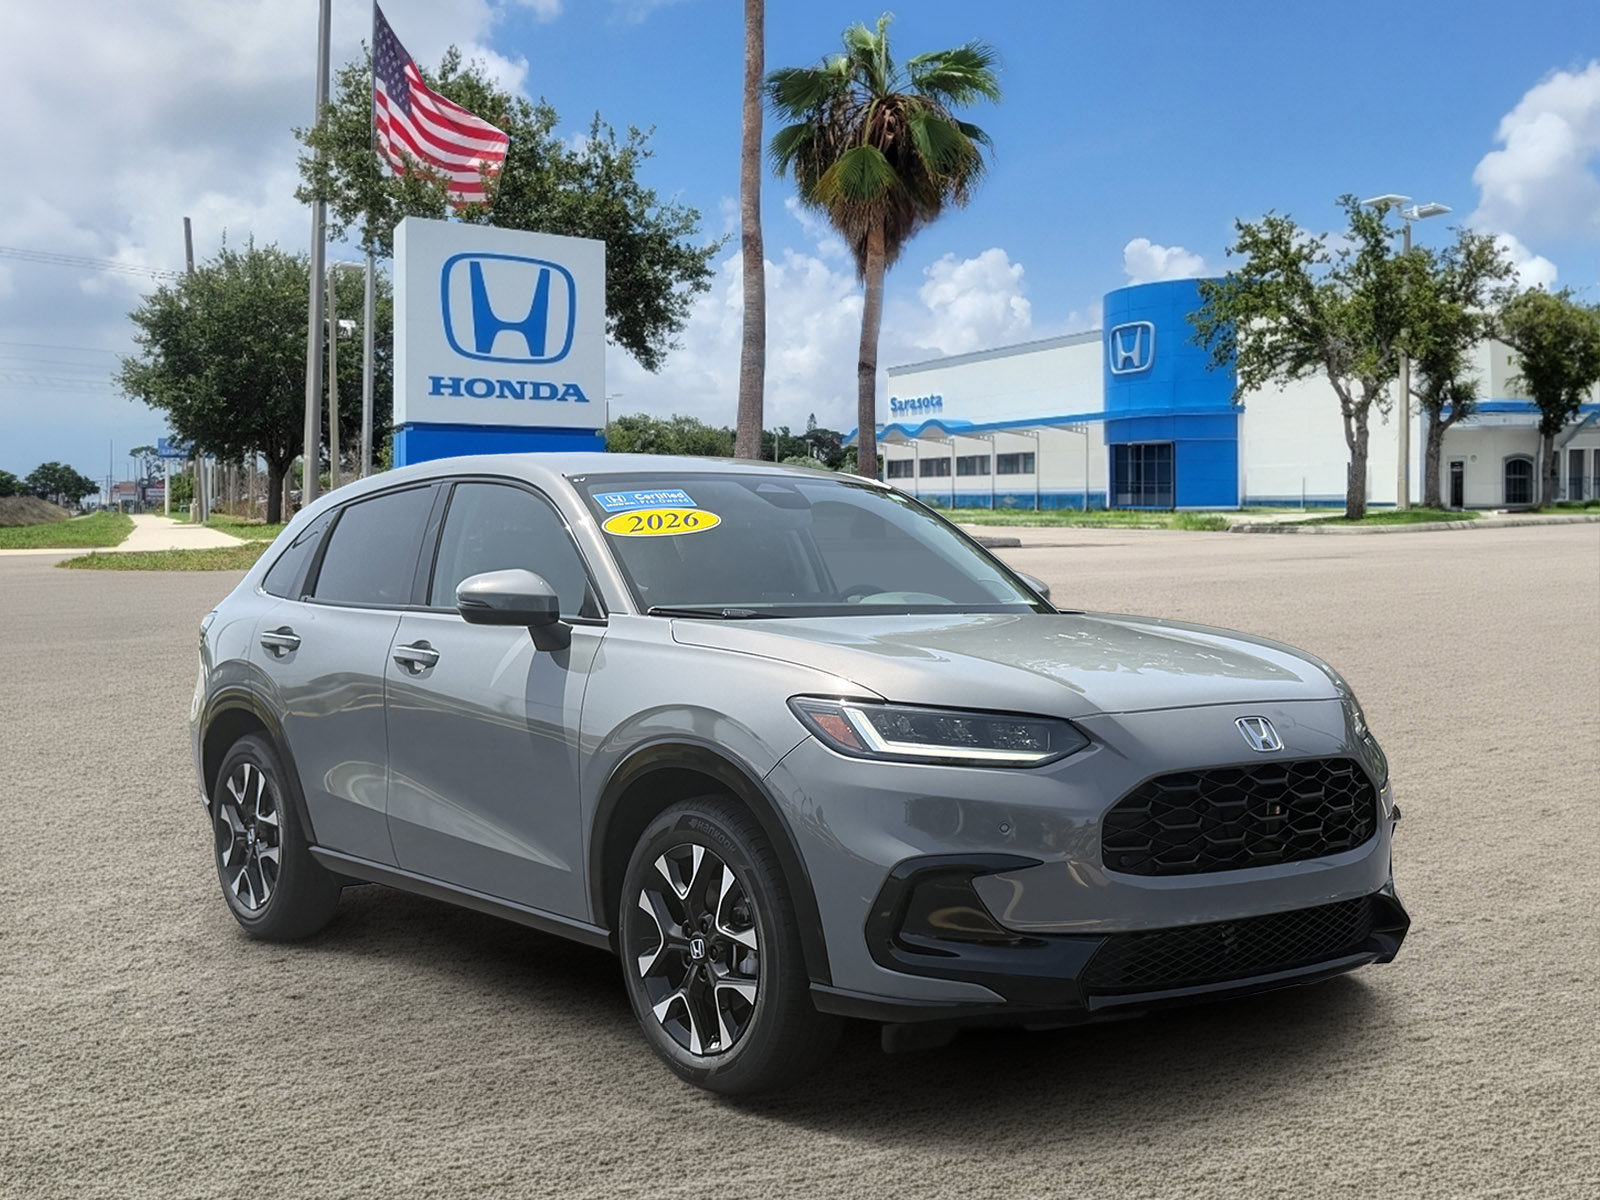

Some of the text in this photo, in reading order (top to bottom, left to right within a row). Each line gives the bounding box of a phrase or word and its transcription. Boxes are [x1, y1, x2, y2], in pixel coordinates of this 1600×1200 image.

[428, 375, 590, 403] HONDA
[890, 393, 943, 412] Sarasota
[634, 492, 684, 500] Certified
[628, 512, 699, 532] 2026
